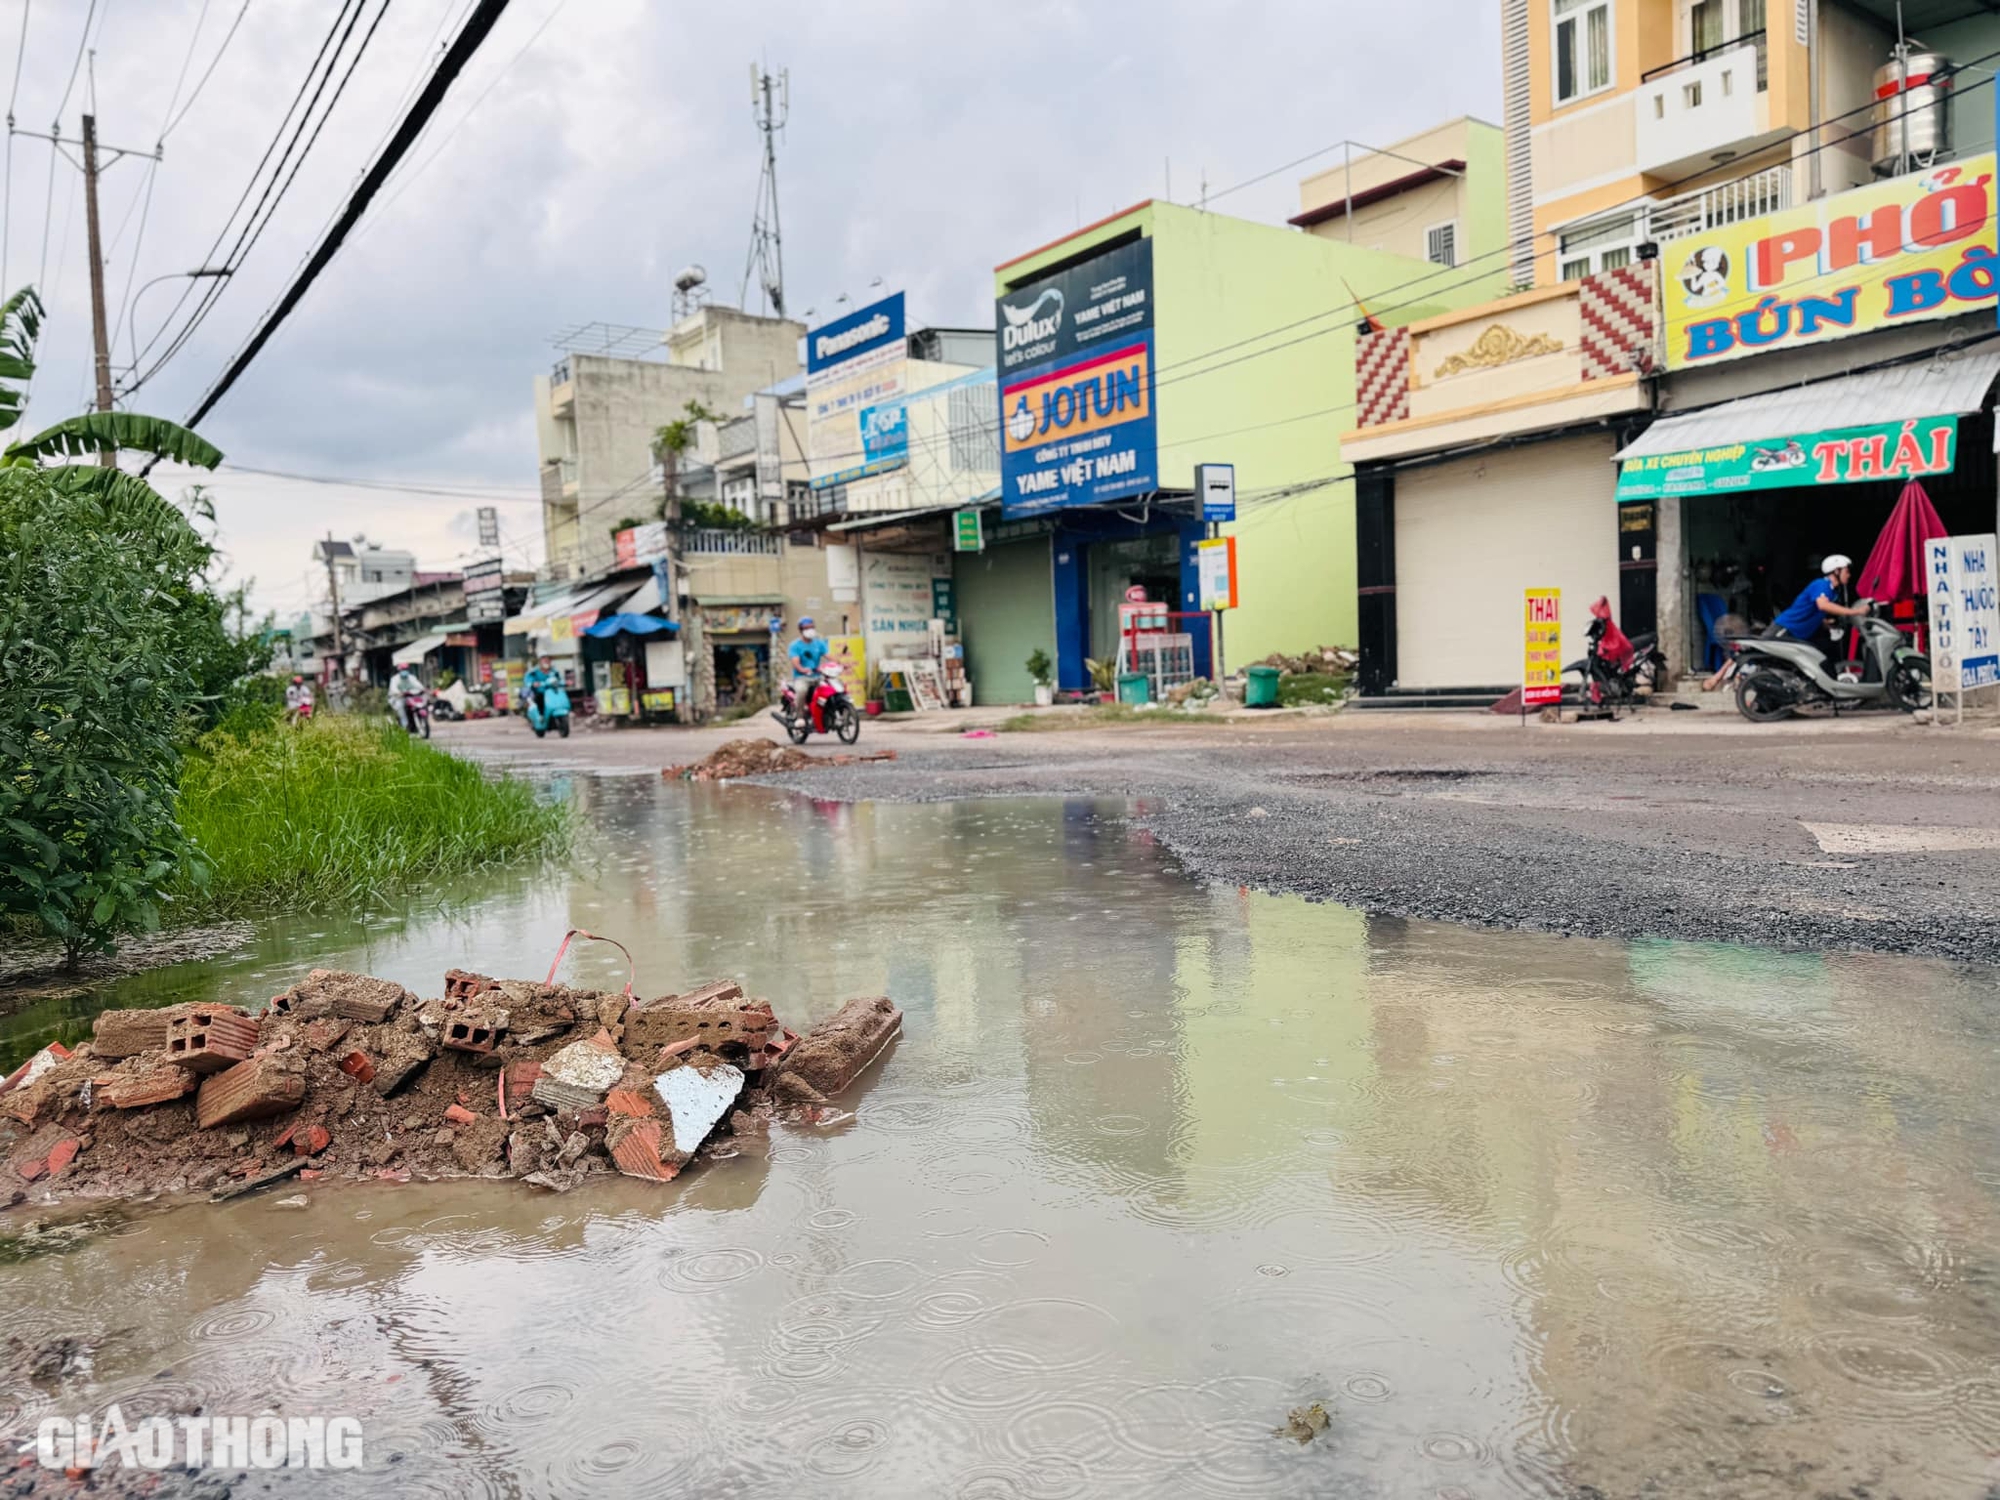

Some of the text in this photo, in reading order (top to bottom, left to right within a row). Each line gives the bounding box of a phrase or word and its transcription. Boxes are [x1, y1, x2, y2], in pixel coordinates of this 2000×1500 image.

[1748, 167, 1992, 291] PHỞ
[1685, 245, 1998, 359] BÚN BÒ
[816, 313, 890, 360] Panasonic
[1003, 315, 1057, 351] Dulux
[1025, 340, 1057, 361] colour
[1038, 364, 1141, 436] JOTUN
[1016, 468, 1060, 495] YAME
[1060, 457, 1095, 488] VIỆT
[1096, 448, 1137, 478] NAM
[1812, 420, 1953, 482] THÁI
[1963, 543, 1987, 574] NHÀ
[1961, 582, 1996, 612] THUỐC
